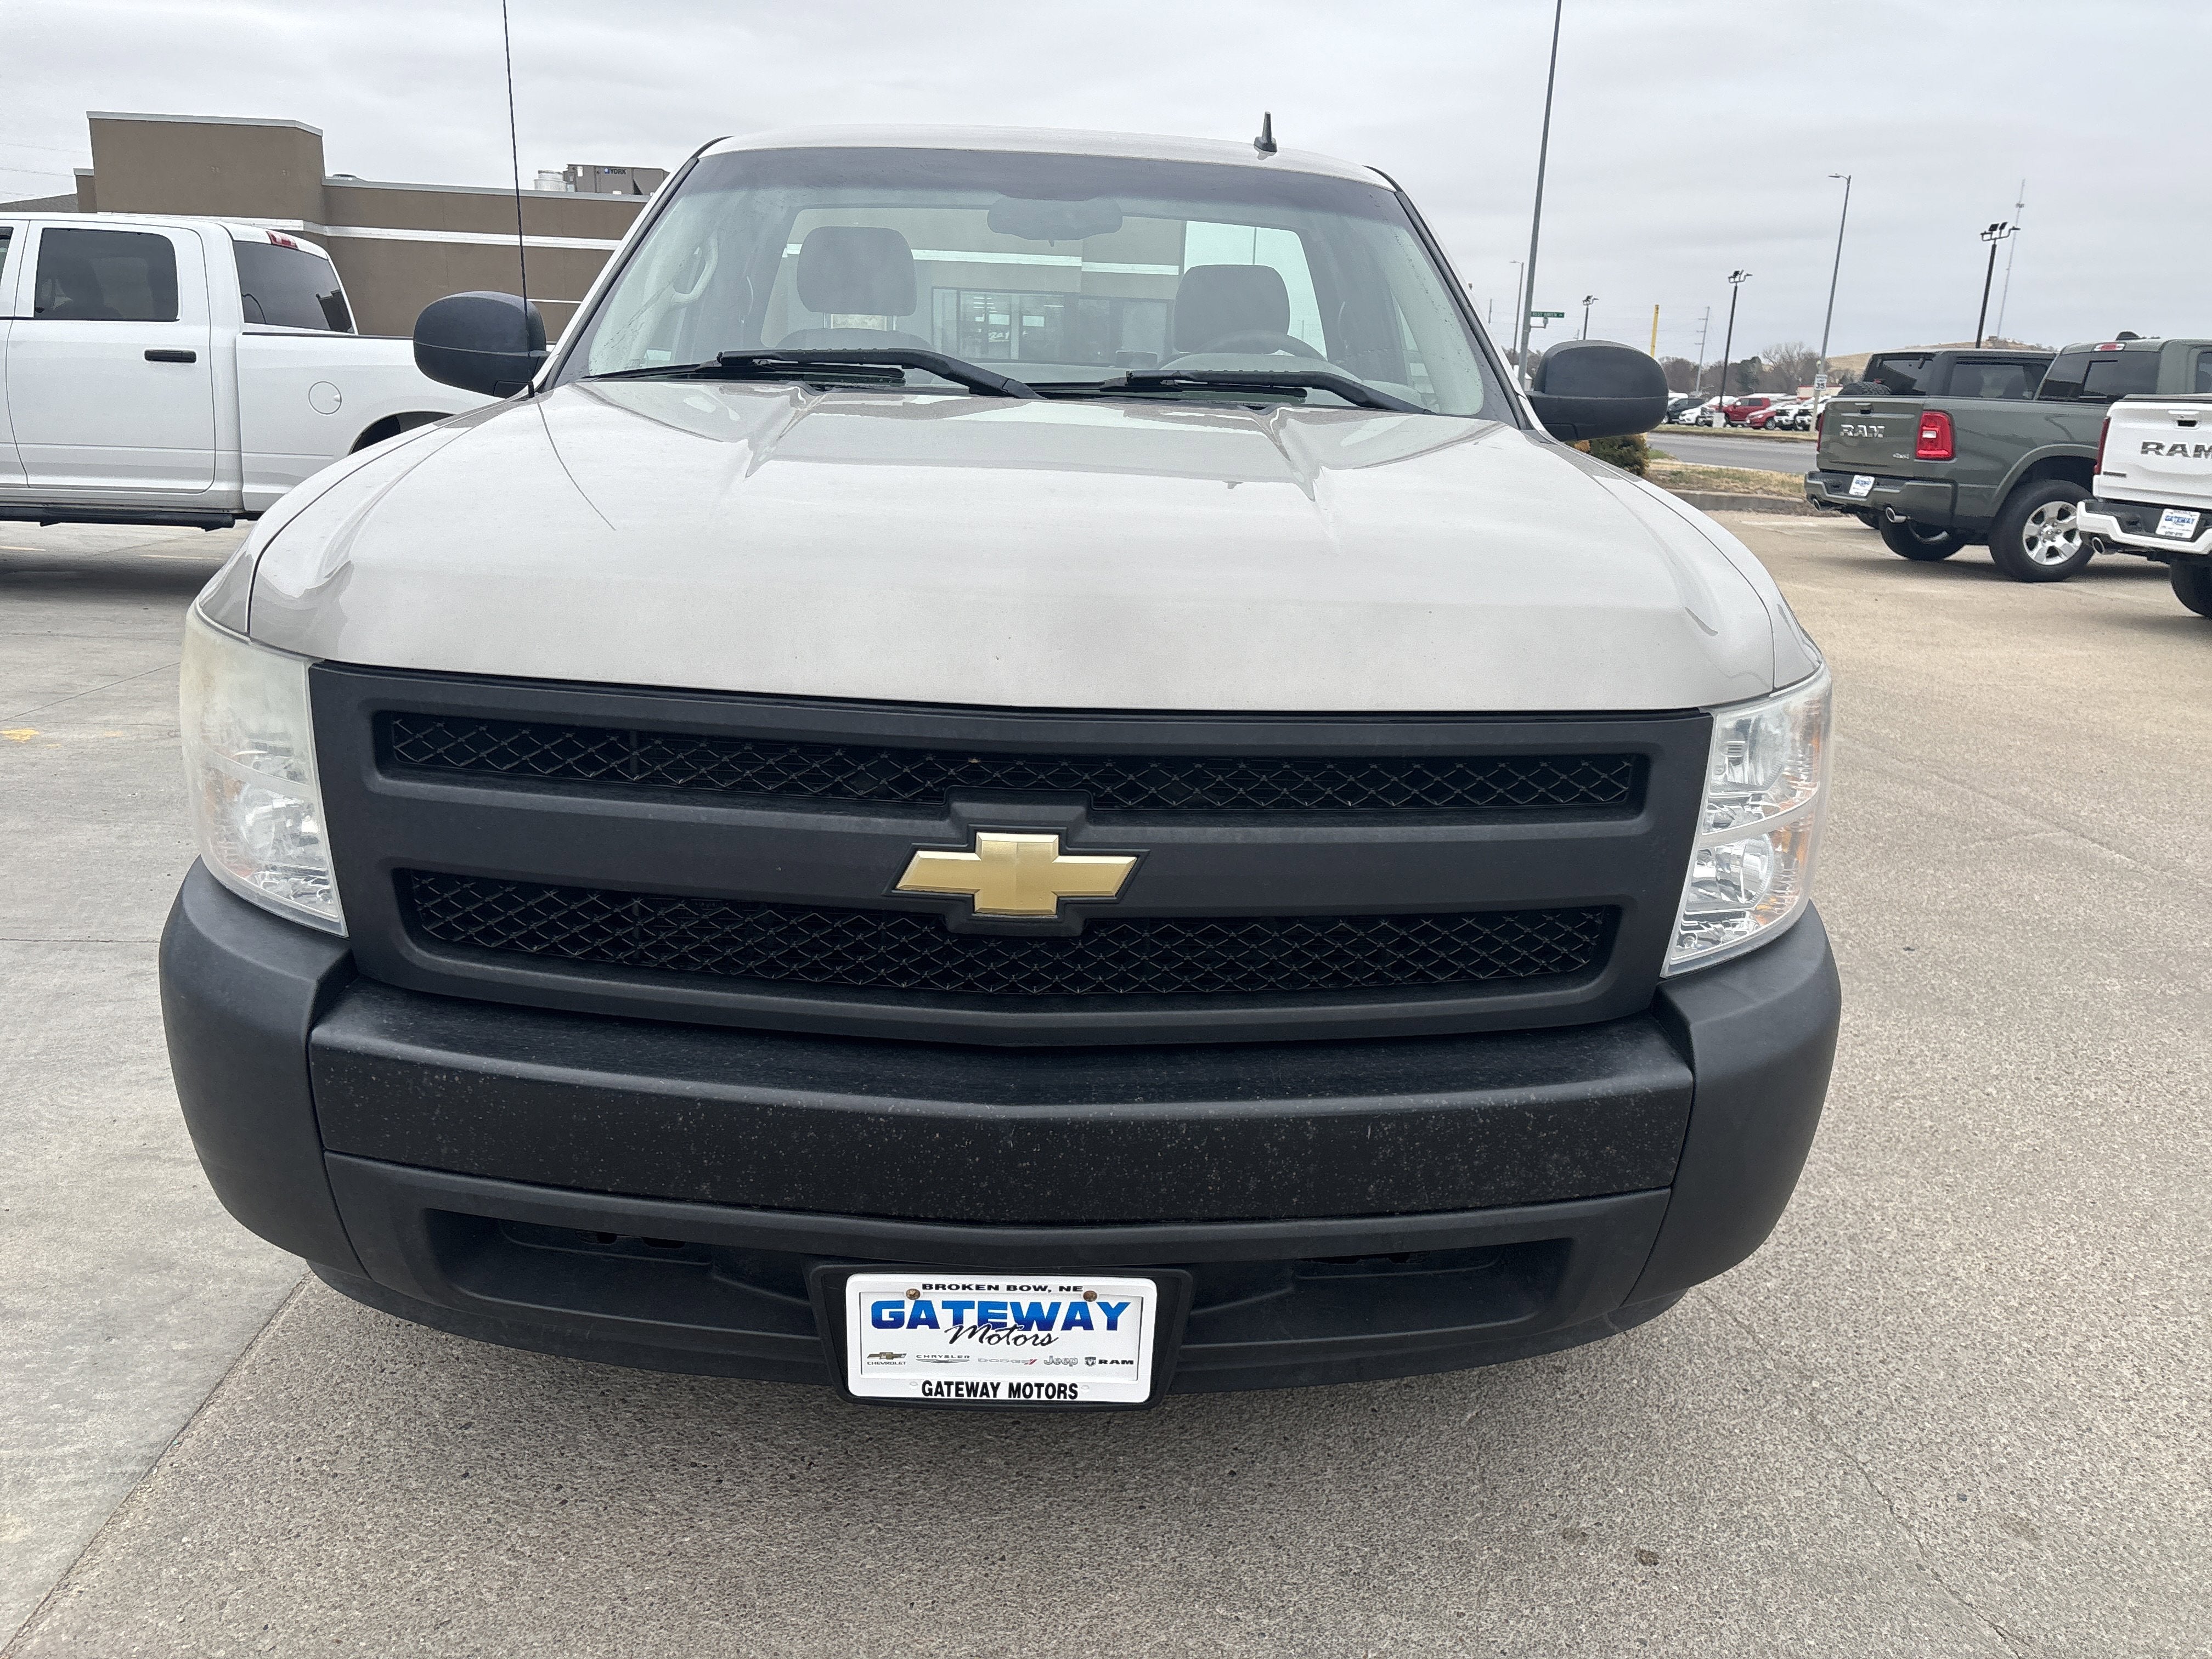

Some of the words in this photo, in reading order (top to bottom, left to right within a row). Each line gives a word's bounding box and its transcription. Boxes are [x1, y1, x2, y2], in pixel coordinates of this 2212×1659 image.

[1839, 424, 1885, 438] RAM
[1006, 1284, 1052, 1293] BOW,
[871, 1300, 1131, 1331] GATEWAY
[944, 1323, 1059, 1346] Motors
[1043, 1355, 1079, 1367] Jeep
[921, 1380, 1001, 1398] GATEWAY
[1008, 1382, 1079, 1400] MOTORS
